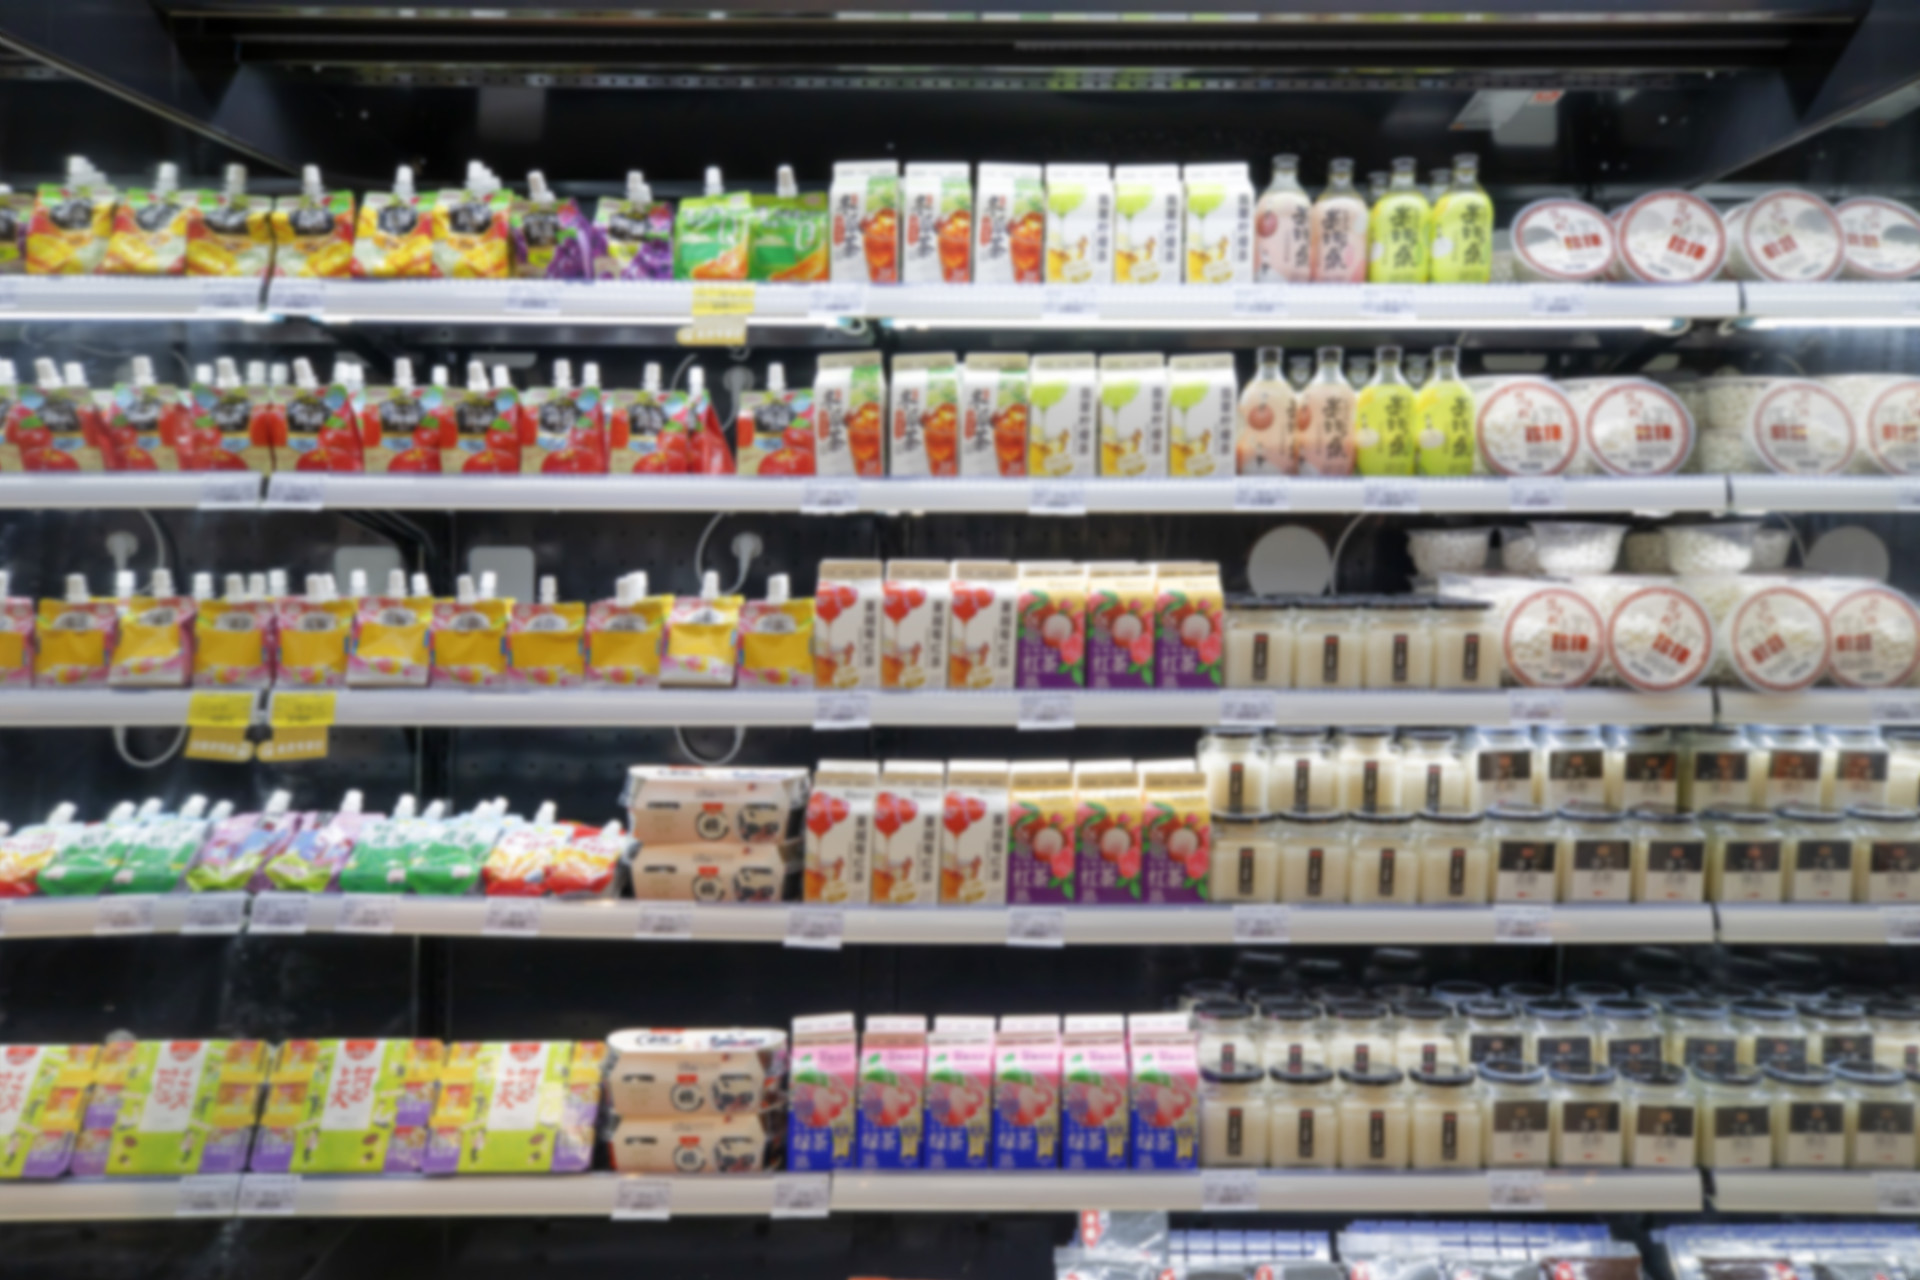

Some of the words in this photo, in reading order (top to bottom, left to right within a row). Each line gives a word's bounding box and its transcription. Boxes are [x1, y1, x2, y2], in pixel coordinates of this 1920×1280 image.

[1023, 655, 1059, 675] 红茶
[1093, 655, 1129, 675] 红茶
[1161, 655, 1197, 675] 红茶
[1013, 867, 1049, 888] 红茶
[1080, 867, 1116, 888] 红茶
[1147, 867, 1184, 888] 红茶
